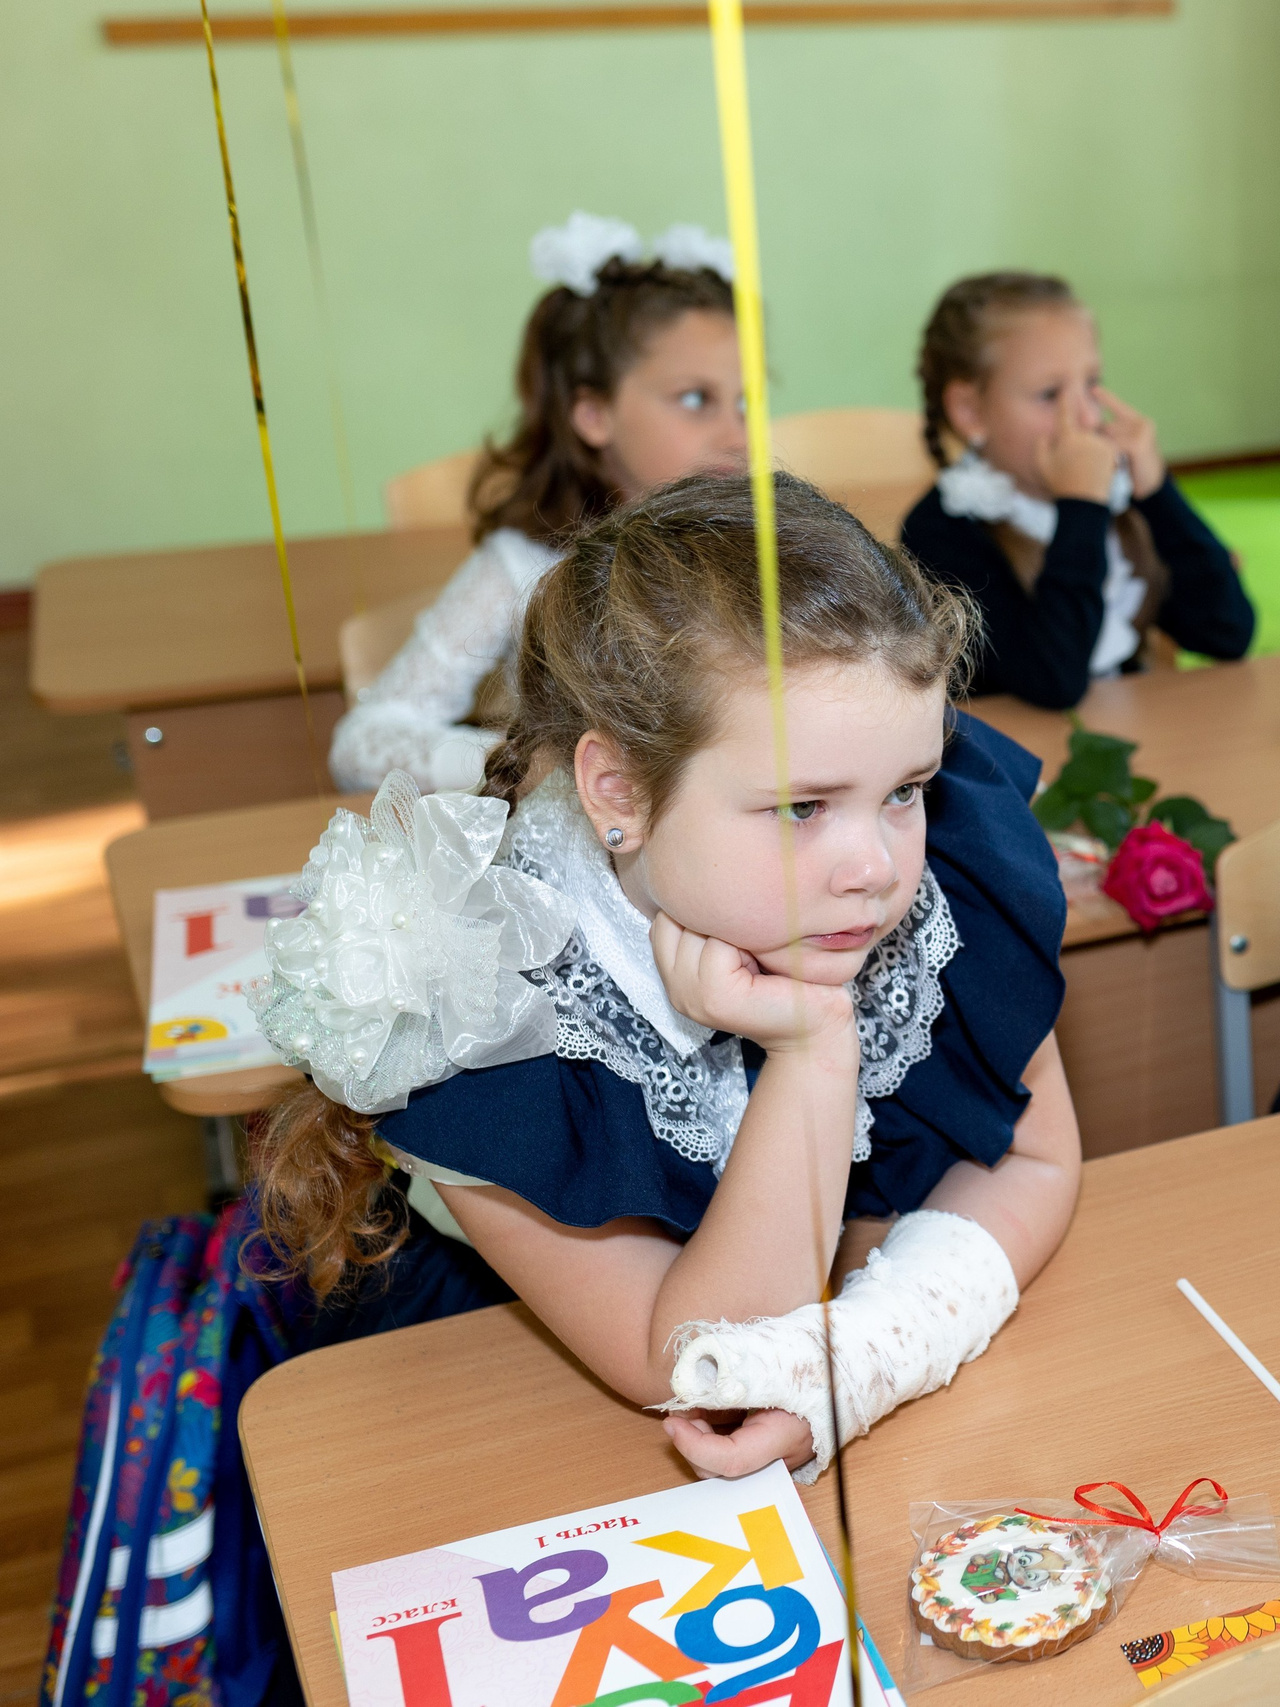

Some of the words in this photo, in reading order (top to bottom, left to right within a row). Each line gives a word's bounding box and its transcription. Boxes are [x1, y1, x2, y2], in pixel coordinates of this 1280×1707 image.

[556, 1515, 641, 1541] Часть
[534, 1535, 549, 1550] 1
[372, 1597, 458, 1628] класс
